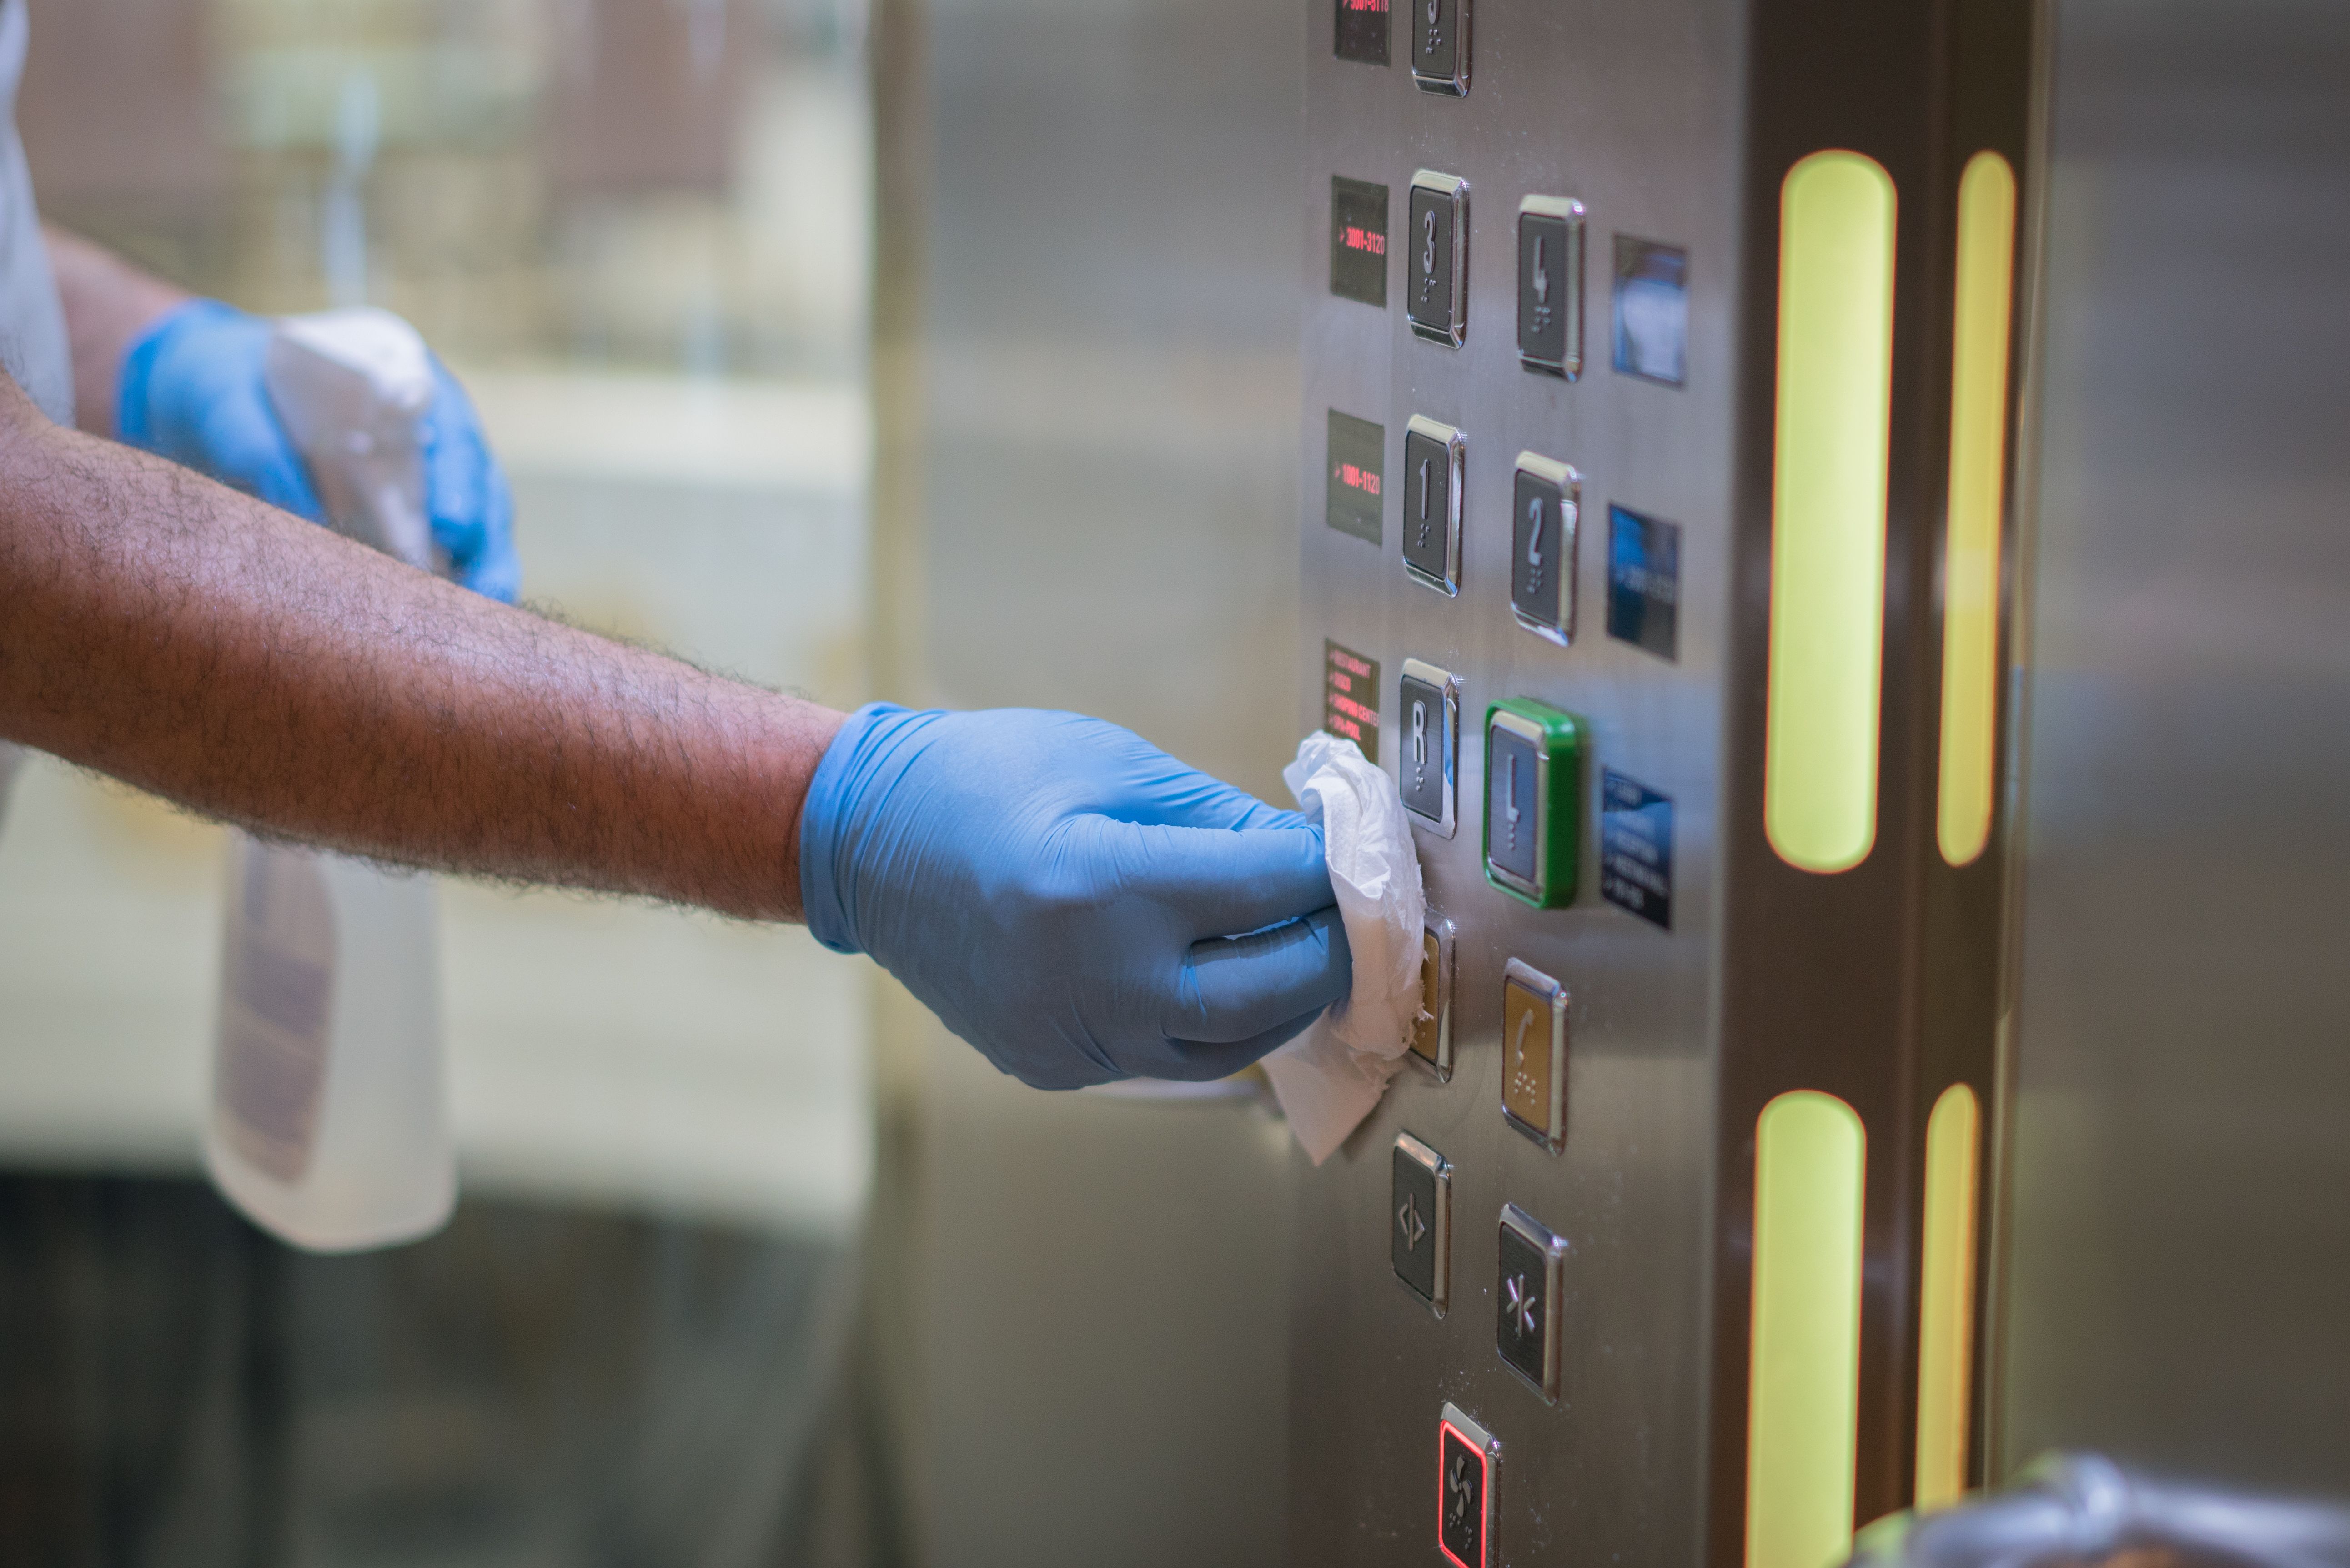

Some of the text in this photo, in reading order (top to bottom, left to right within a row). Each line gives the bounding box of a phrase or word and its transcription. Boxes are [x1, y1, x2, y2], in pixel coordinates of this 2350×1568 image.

[1346, 226, 1385, 255] 3001-3120
[1423, 210, 1436, 275] 3
[1533, 235, 1548, 304] 4
[1342, 463, 1380, 495] 1001-1120
[1420, 458, 1430, 520] 1
[1528, 497, 1544, 566] 2
[1334, 649, 1371, 679] RESTAURANT
[1413, 699, 1427, 765] R
[1506, 753, 1521, 822] L
